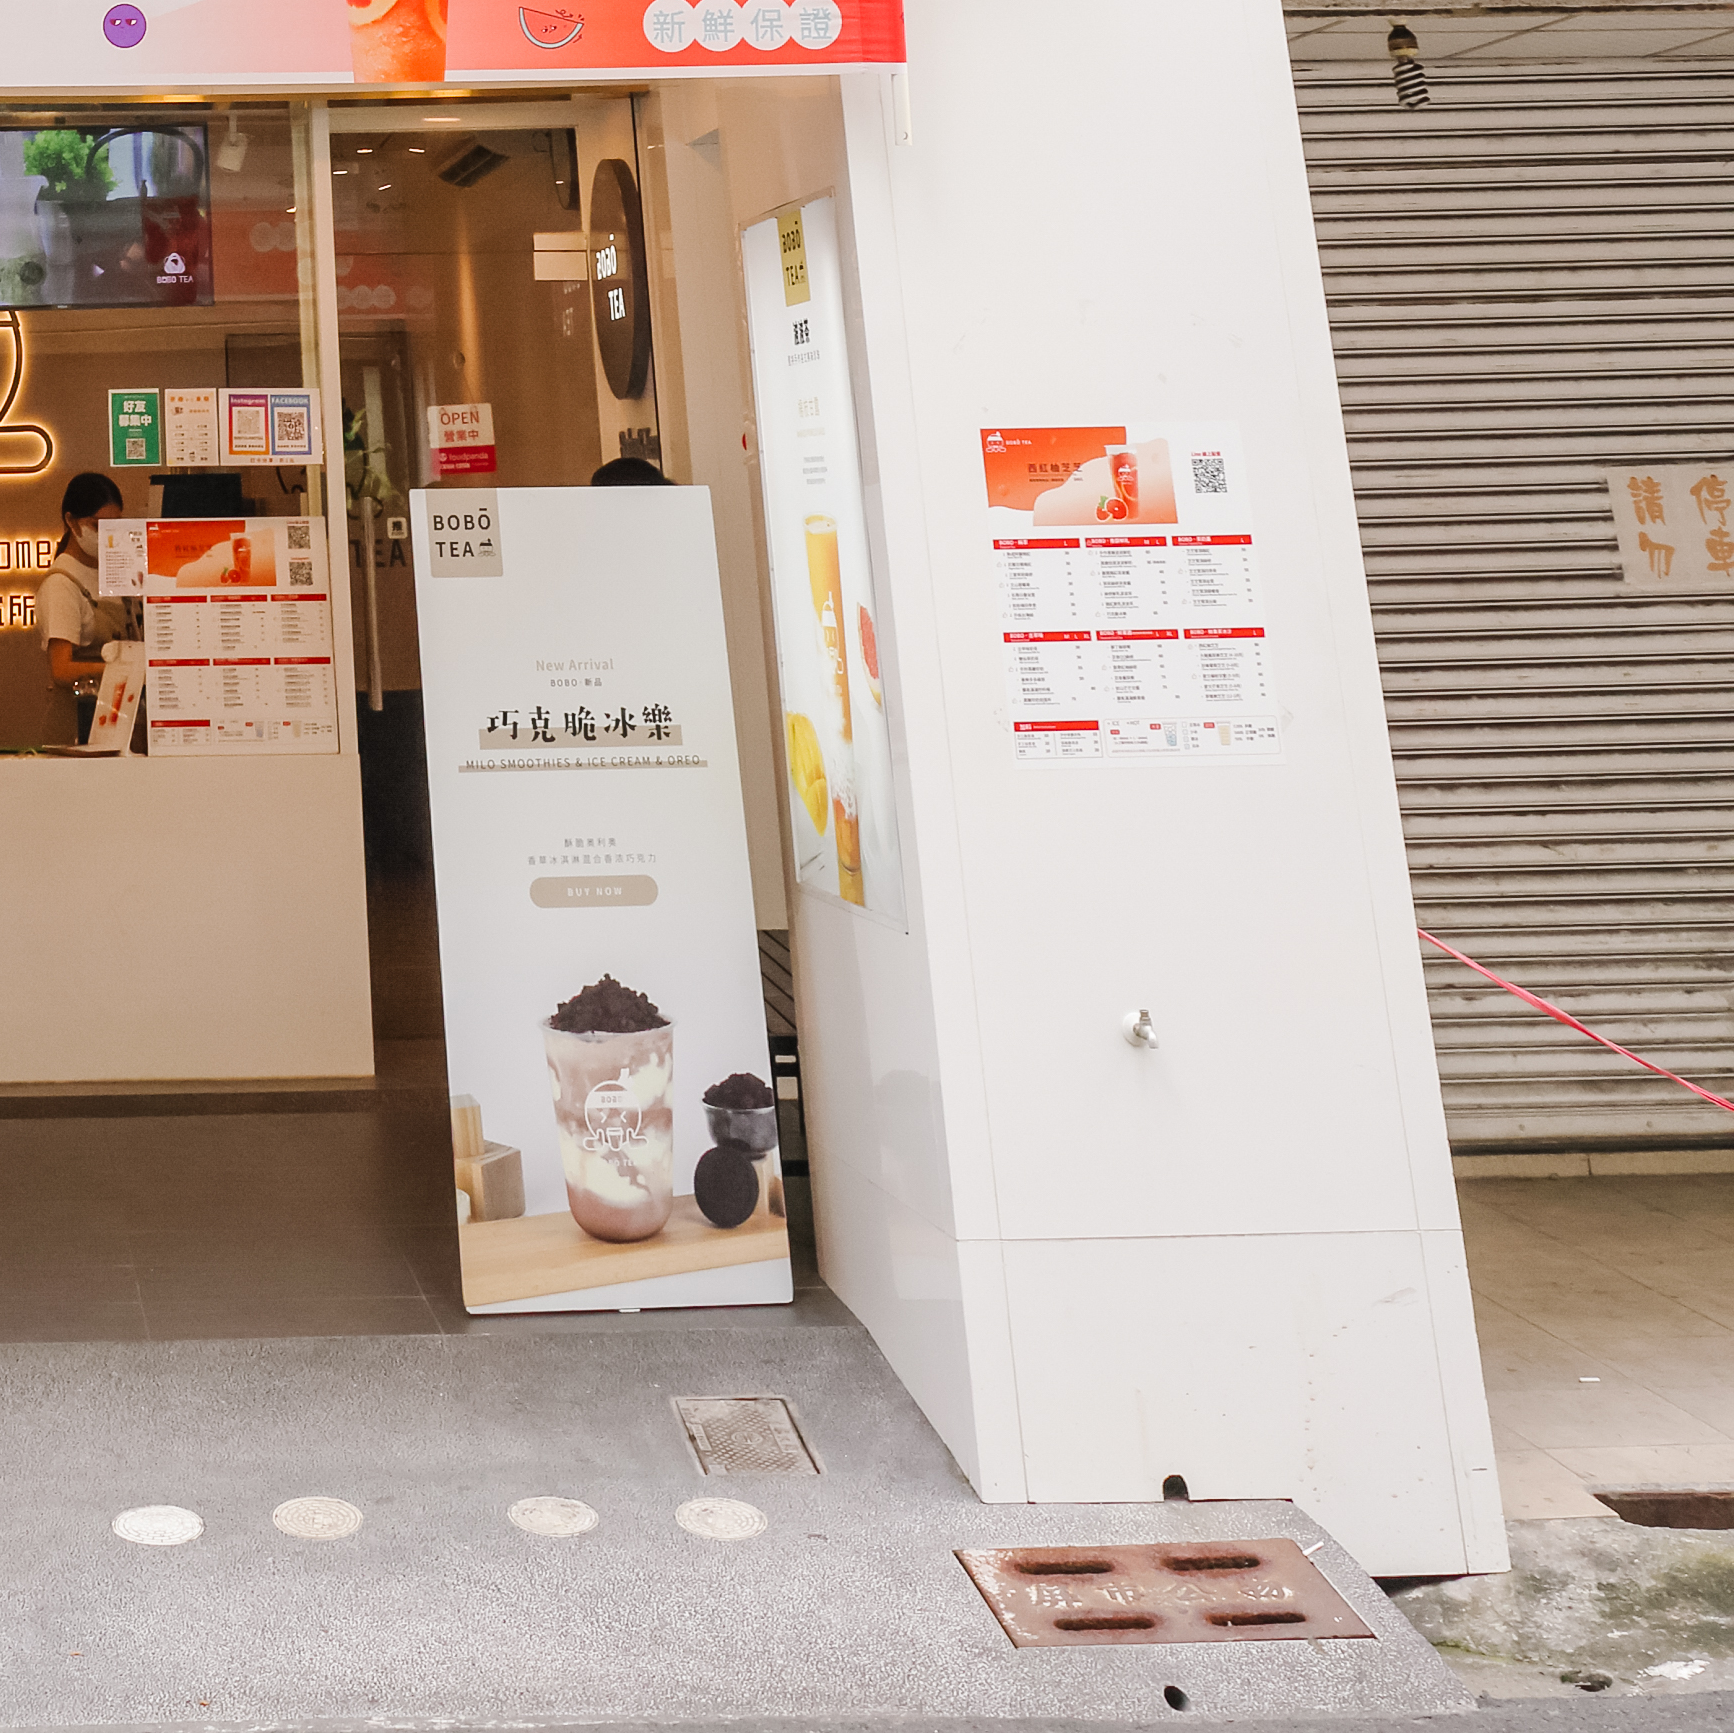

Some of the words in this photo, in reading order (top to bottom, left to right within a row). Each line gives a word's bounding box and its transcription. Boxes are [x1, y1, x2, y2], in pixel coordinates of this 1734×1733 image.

[652, 7, 839, 45] 新鮮保證
[607, 287, 626, 321] TEA
[440, 411, 480, 426] OPEN
[1626, 475, 1676, 580] 請勿
[1689, 473, 1734, 578] 停車
[435, 541, 475, 558] TEA
[535, 659, 565, 672] New
[568, 658, 615, 671] Arrival
[485, 703, 673, 743] 巧克脆冰樂
[466, 759, 496, 771] MILO
[500, 757, 571, 769] SMOOTHIES
[587, 756, 607, 768] ICE
[611, 756, 651, 767] CREAM
[667, 754, 701, 766] OREO
[567, 886, 591, 897] BUY
[596, 885, 623, 896] NOW
